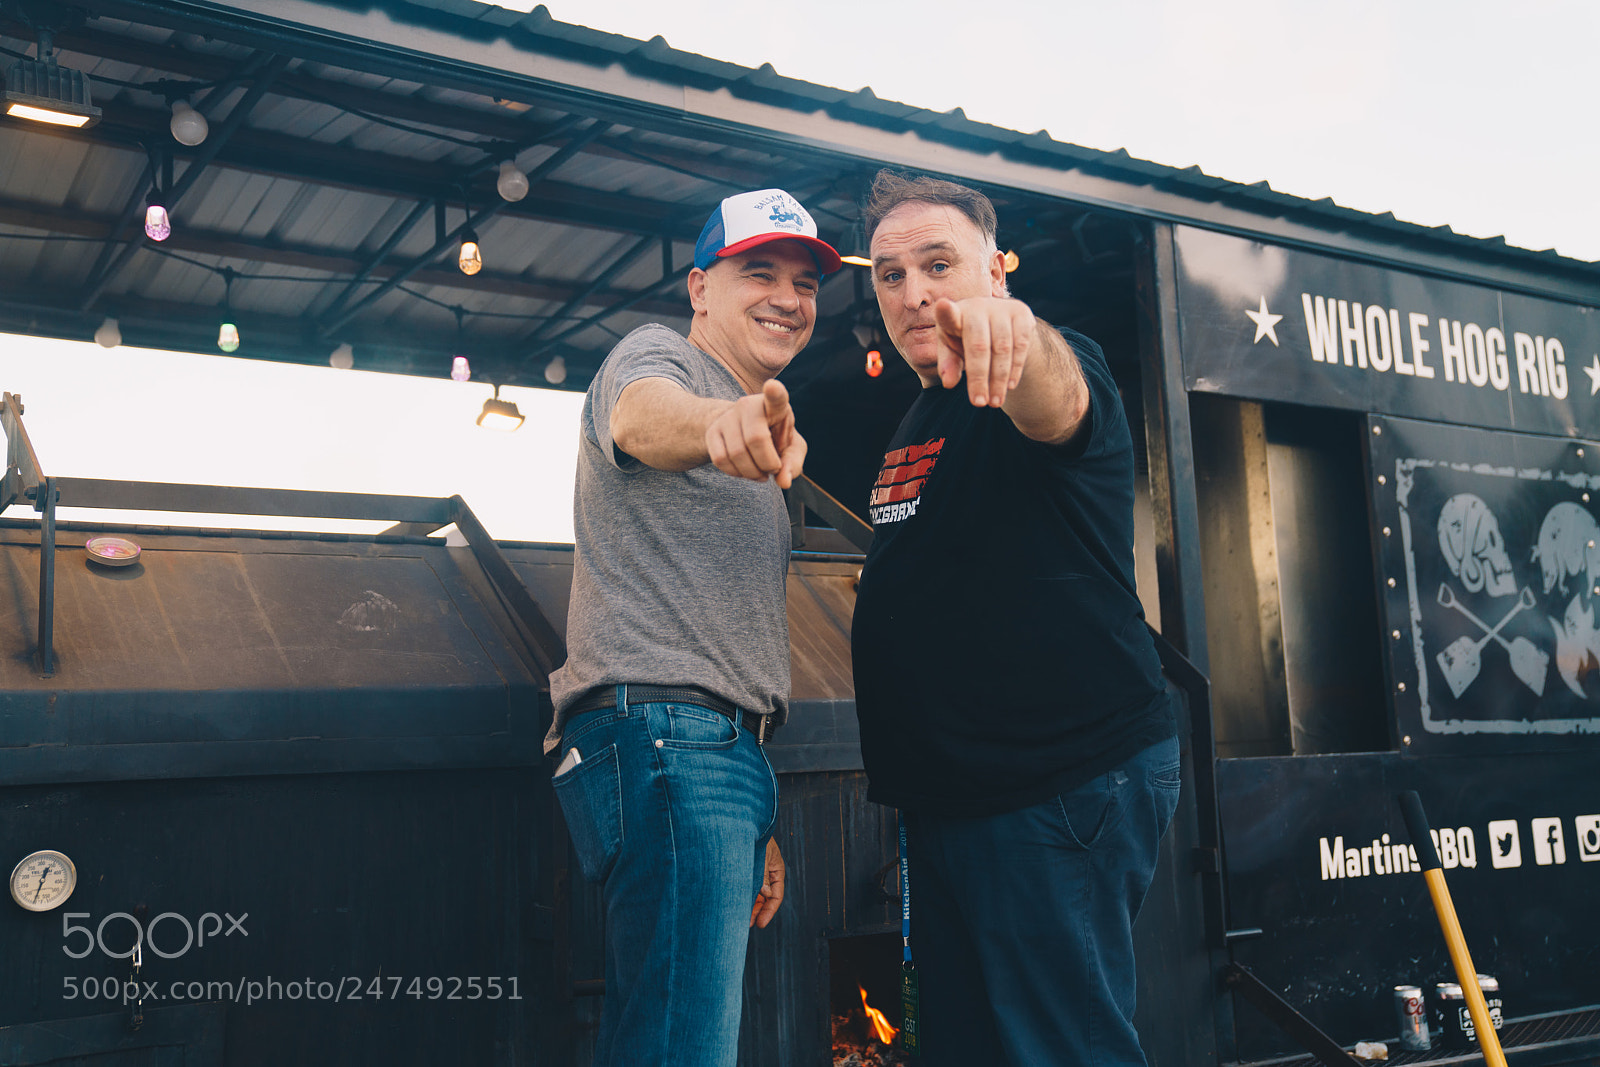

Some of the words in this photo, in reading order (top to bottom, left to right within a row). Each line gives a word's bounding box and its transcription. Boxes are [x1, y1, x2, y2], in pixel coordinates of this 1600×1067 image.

[754, 194, 784, 210] BALSAM
[1301, 293, 1435, 379] WHOLE
[1439, 317, 1510, 391] HOG
[1513, 331, 1569, 400] RIG
